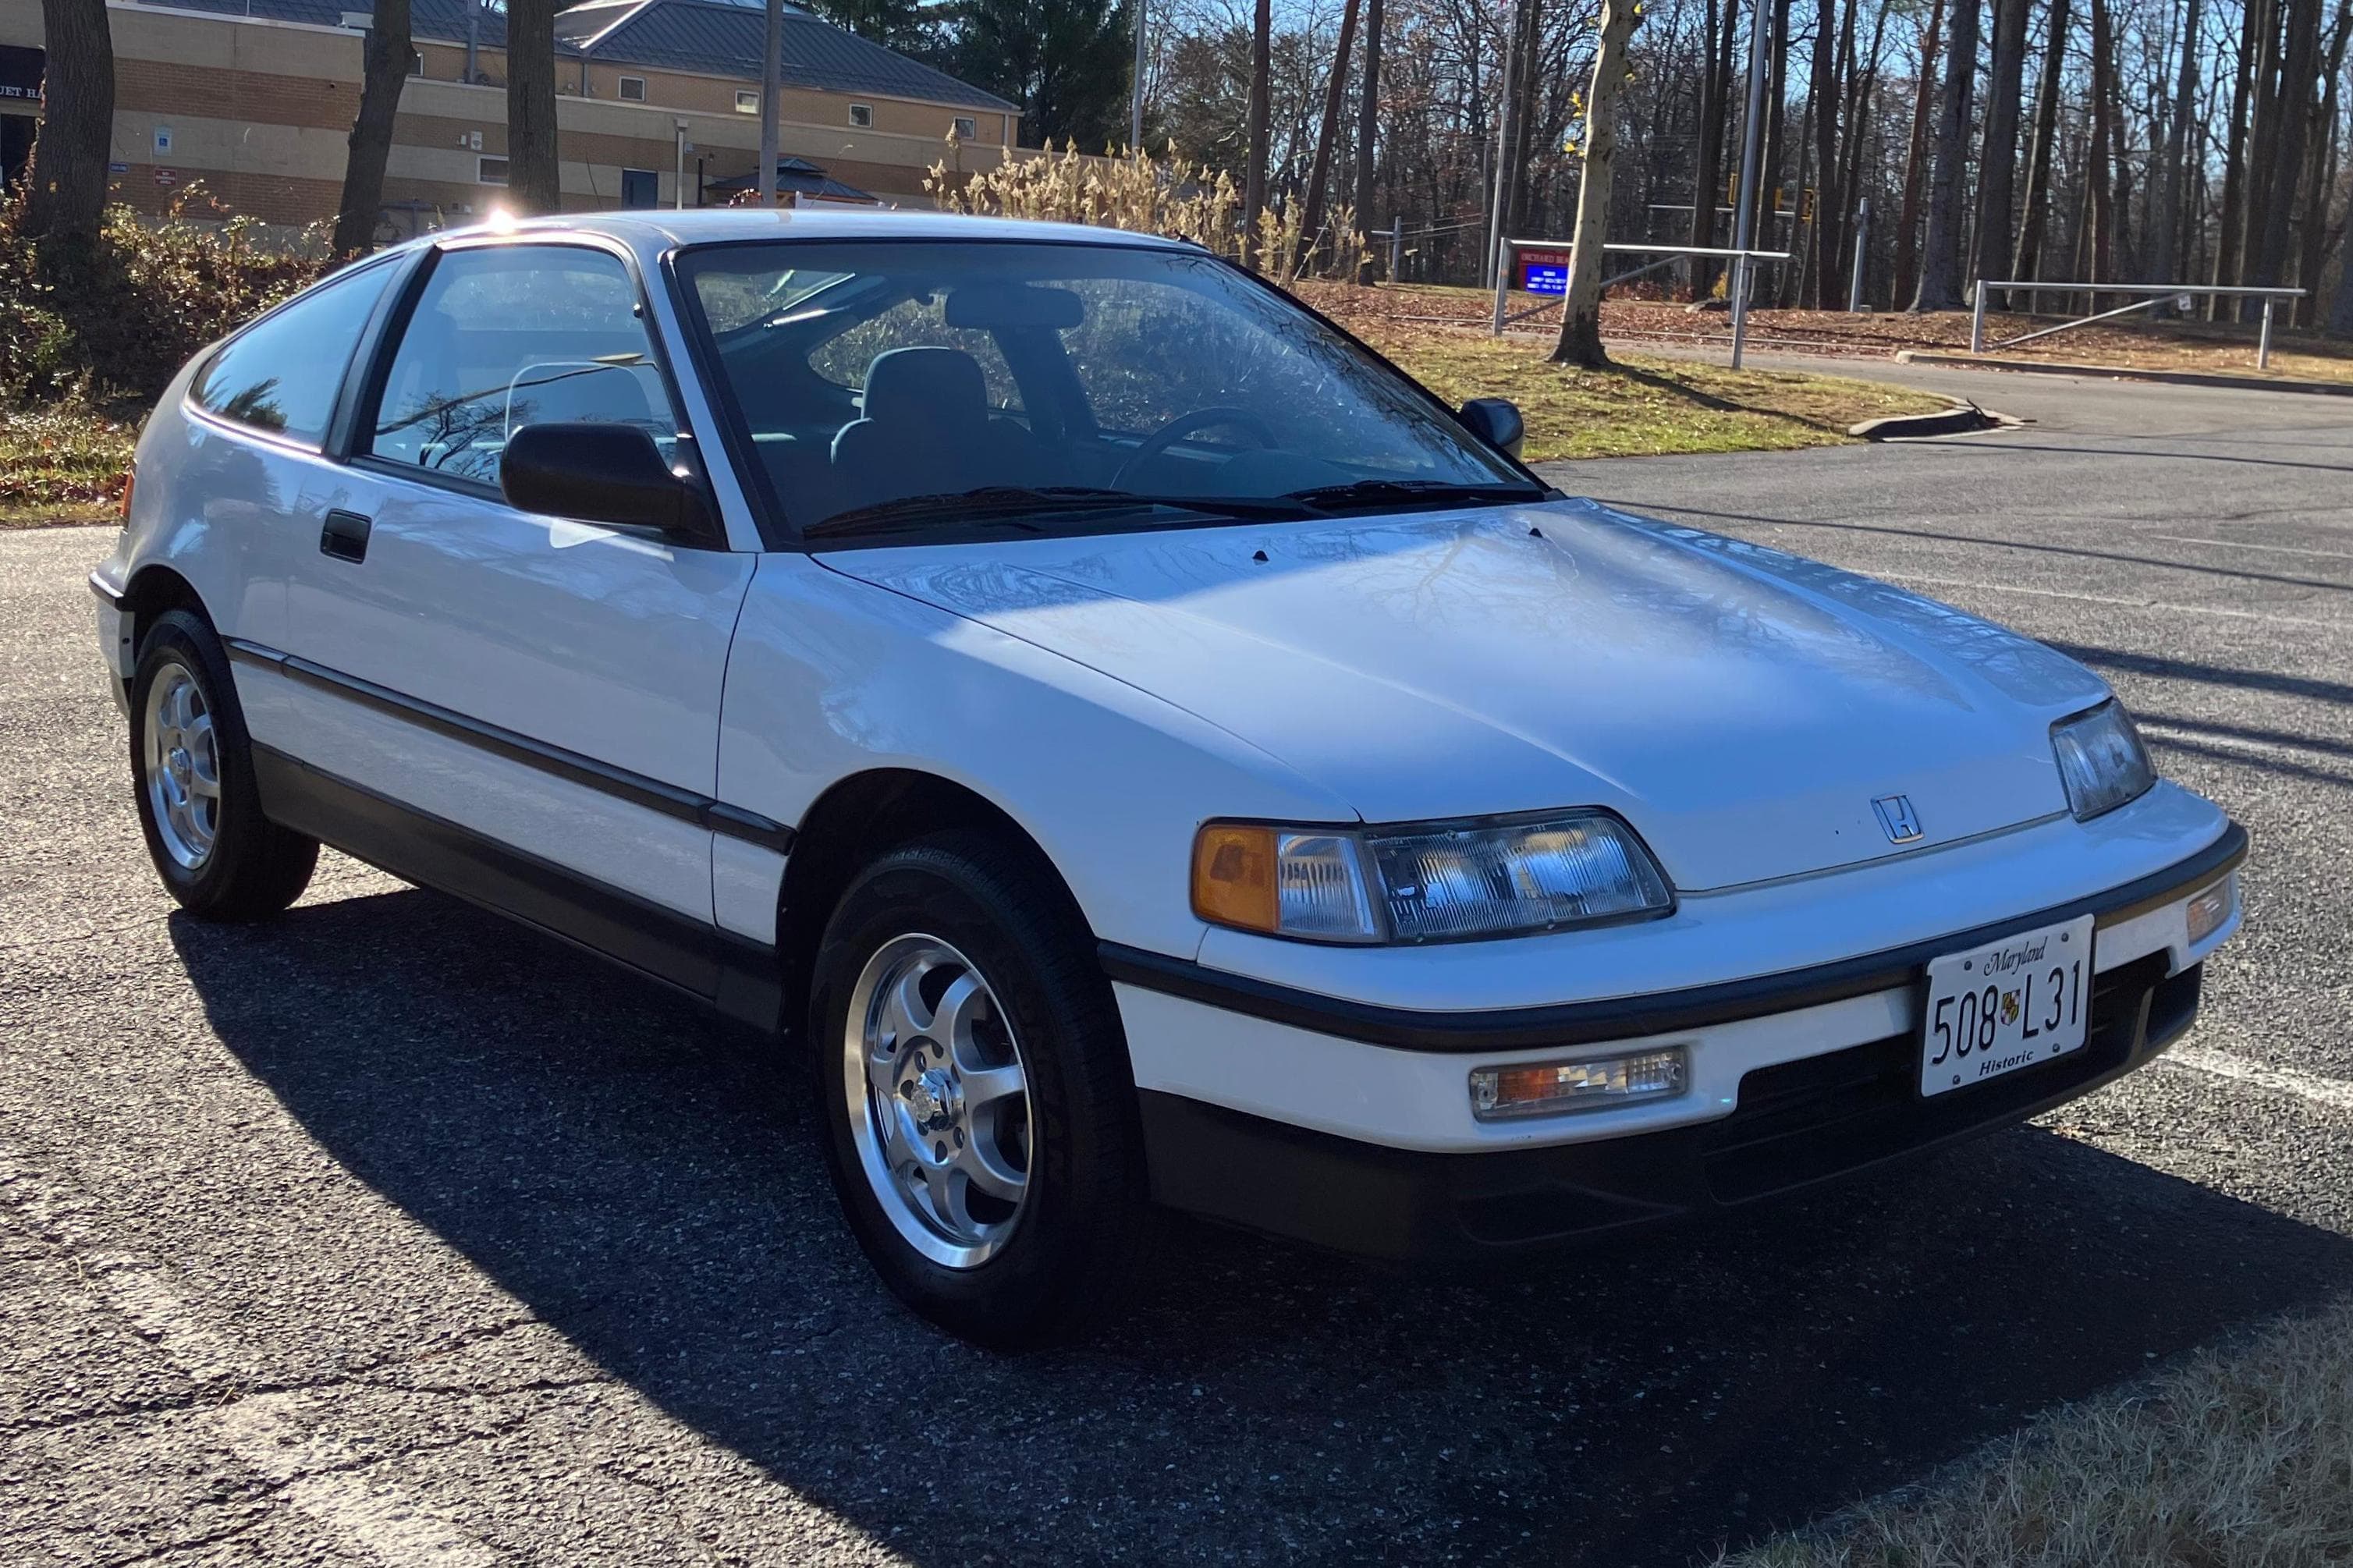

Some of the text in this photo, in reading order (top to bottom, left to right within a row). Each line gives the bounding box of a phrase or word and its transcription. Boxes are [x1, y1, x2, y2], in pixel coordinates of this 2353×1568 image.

[1521, 253, 1555, 263] ORCHARD
[1983, 936, 2048, 977] Maryland
[1932, 960, 2081, 1065] 508 L31
[1979, 1049, 2034, 1077] Historic
